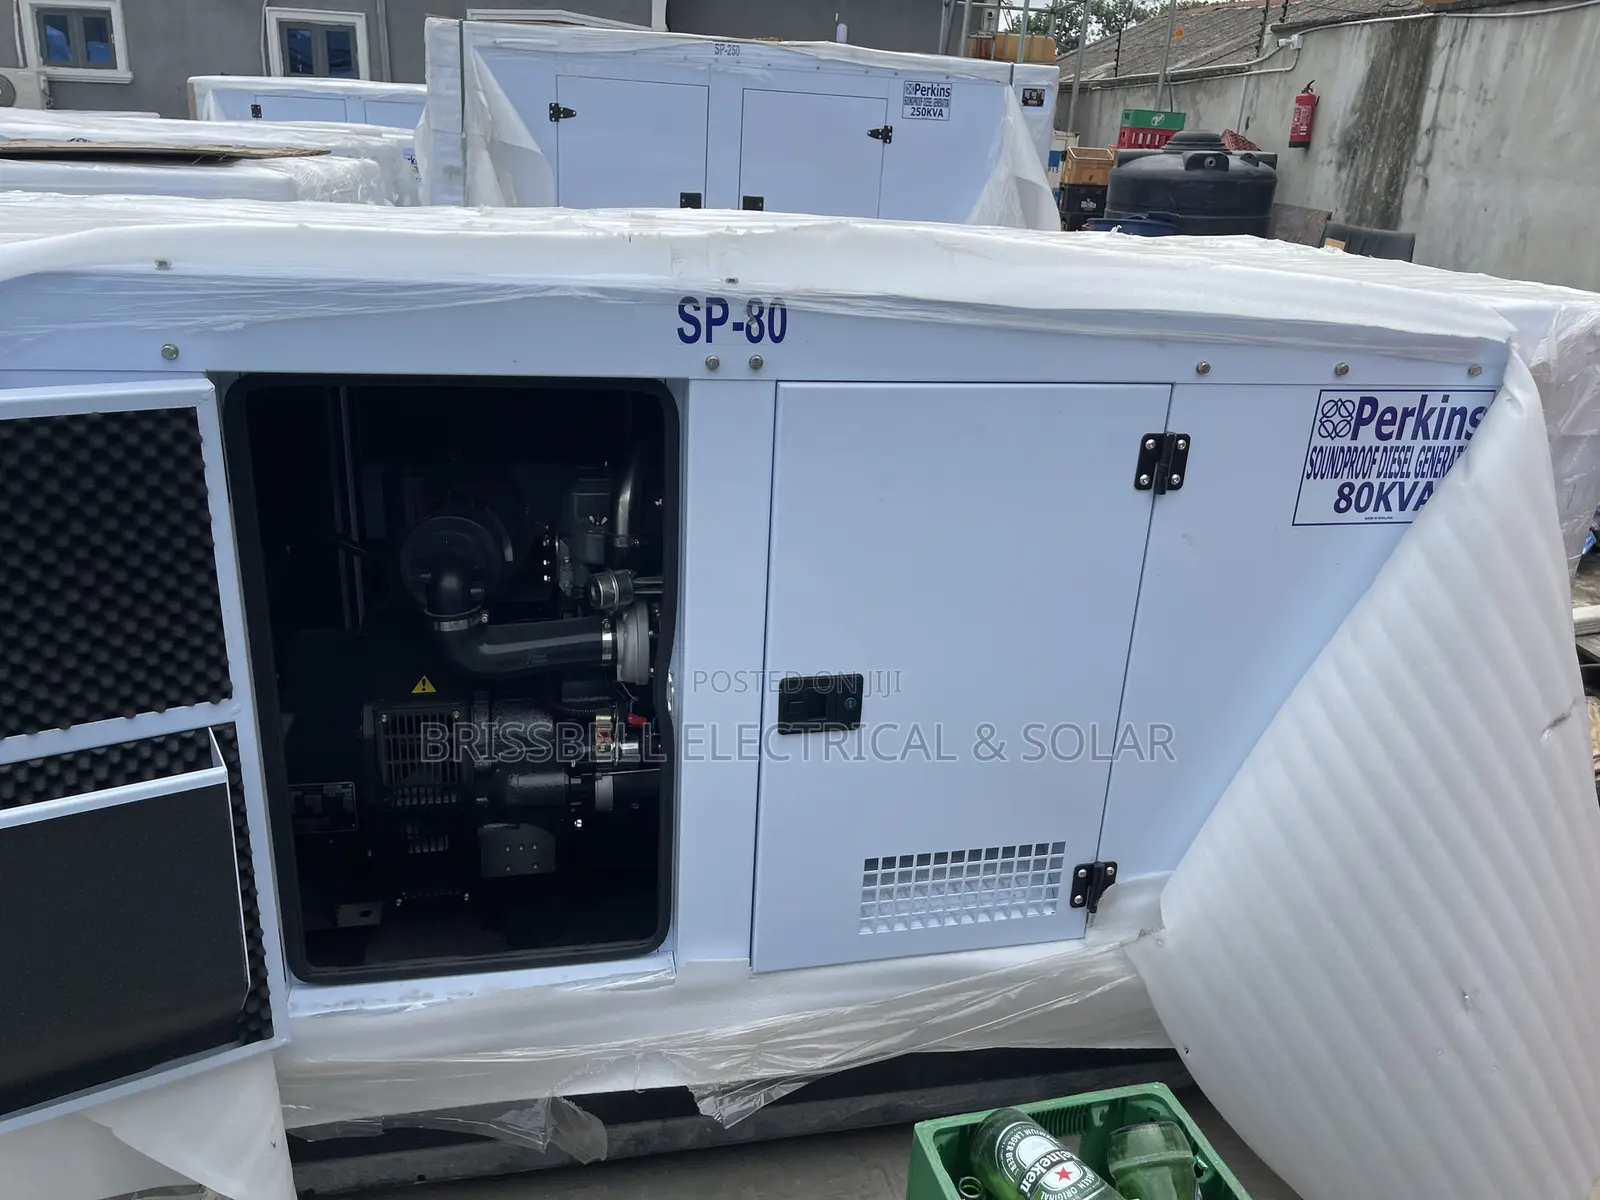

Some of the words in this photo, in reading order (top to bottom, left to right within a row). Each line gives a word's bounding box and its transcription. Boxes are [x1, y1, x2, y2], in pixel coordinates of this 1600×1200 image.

[714, 43, 740, 57] SP-250
[914, 83, 951, 98] Perkins
[910, 106, 944, 118] 250KVA
[677, 296, 788, 345] SP-80
[1350, 394, 1489, 442] Perkins
[1306, 445, 1380, 480] SOUNDPROOF
[1376, 445, 1415, 480] DIESEL
[1333, 481, 1434, 515] 80KVA
